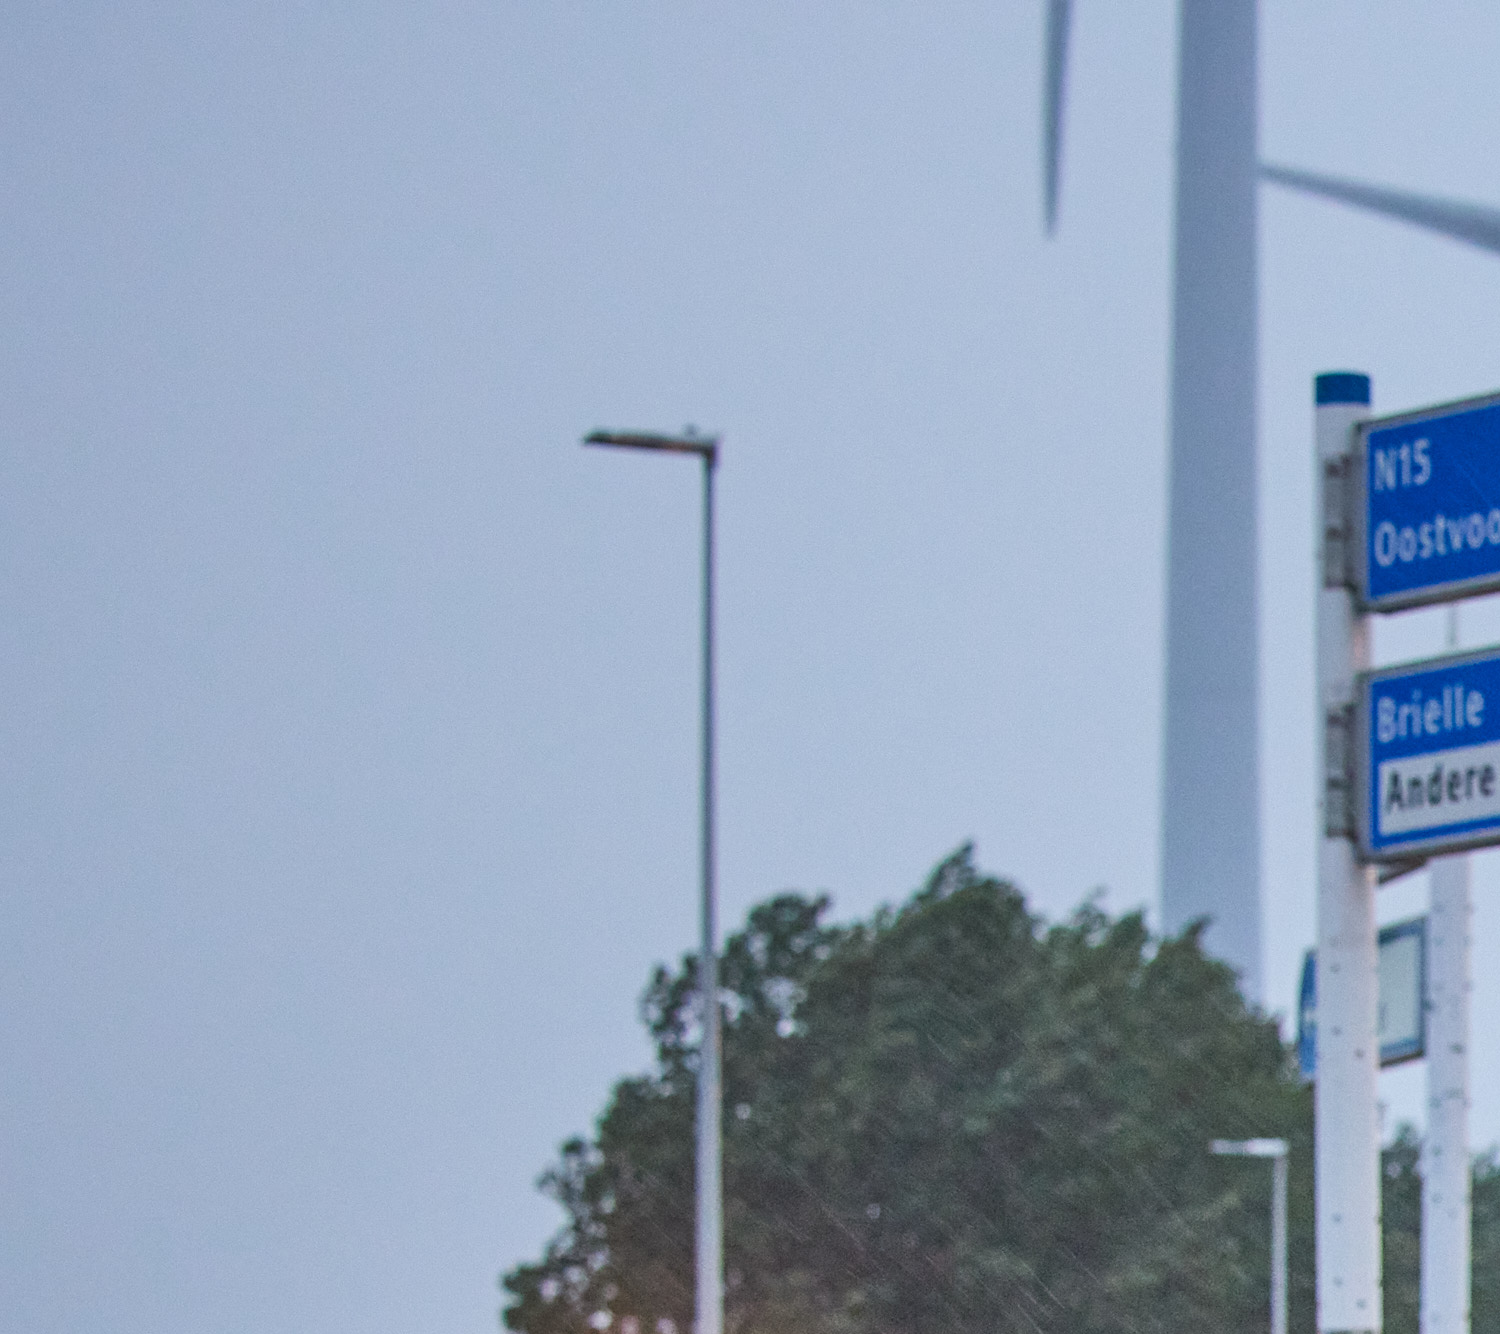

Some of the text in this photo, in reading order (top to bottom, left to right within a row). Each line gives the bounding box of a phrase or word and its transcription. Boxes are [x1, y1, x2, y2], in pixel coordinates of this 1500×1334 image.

[1374, 439, 1432, 492] N15
[1377, 683, 1485, 744] Brielle
[1386, 752, 1495, 813] Andere
